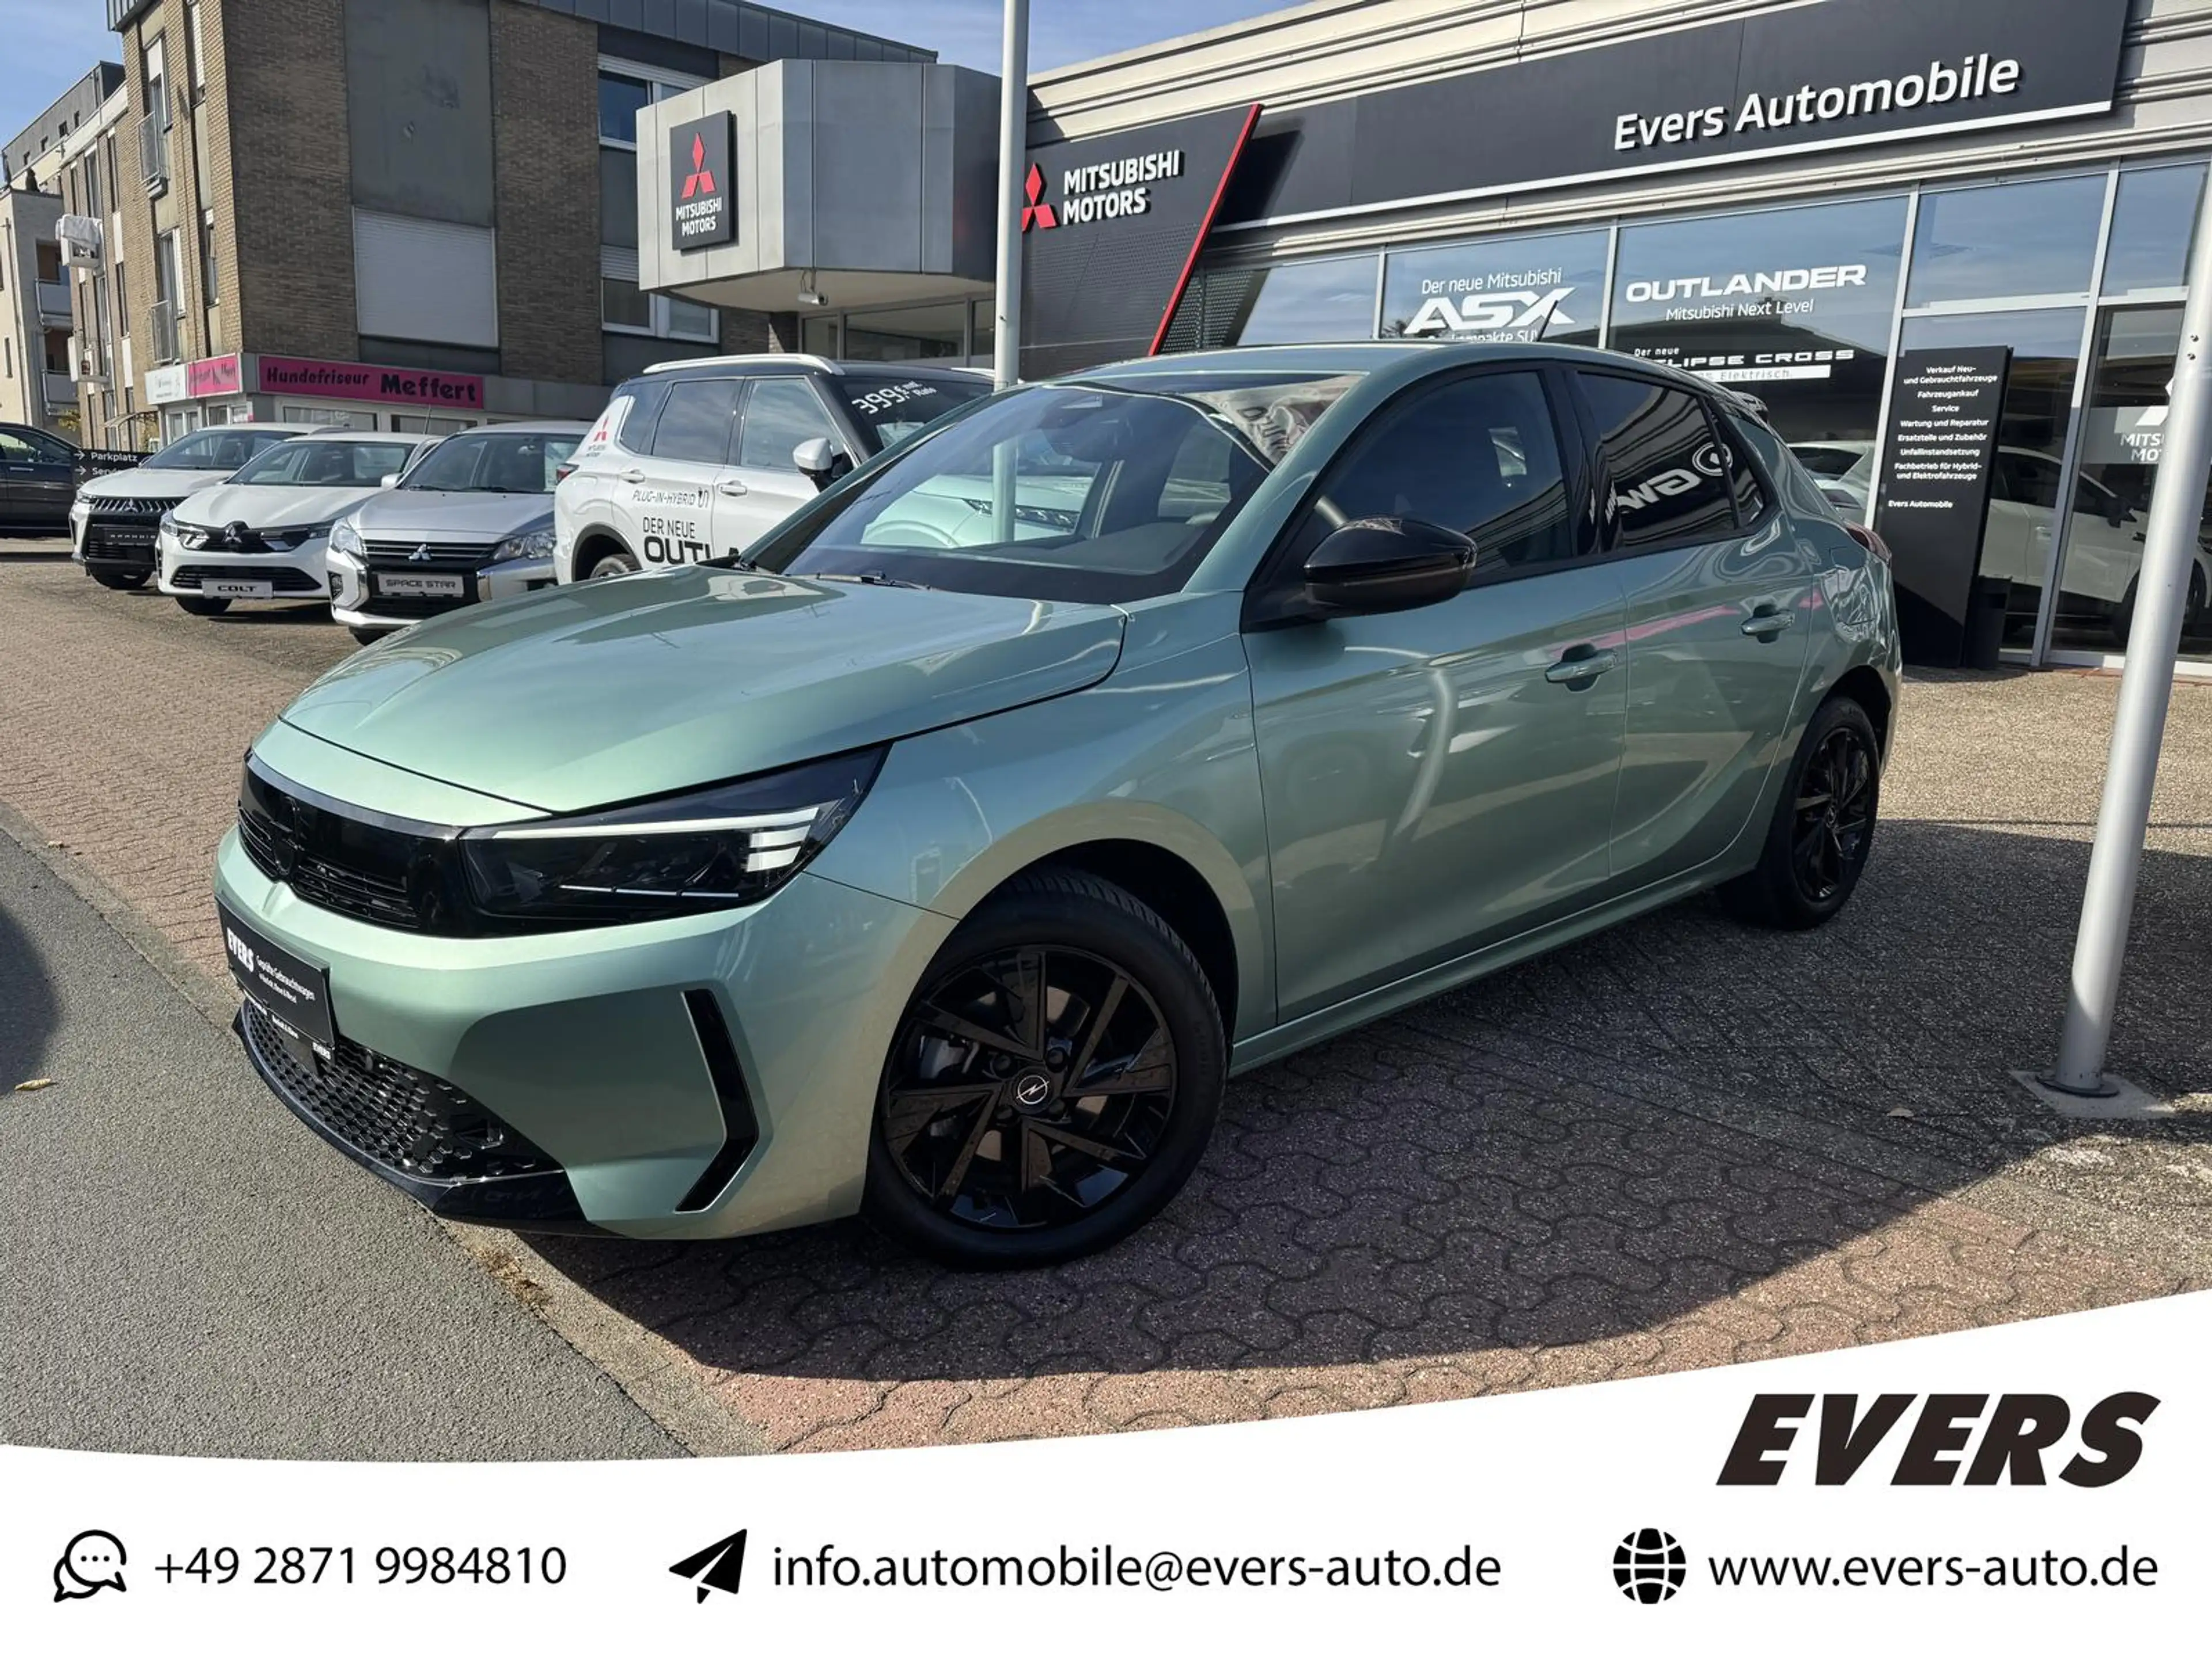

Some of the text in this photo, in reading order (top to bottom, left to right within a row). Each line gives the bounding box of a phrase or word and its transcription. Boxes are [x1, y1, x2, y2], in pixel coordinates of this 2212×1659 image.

[1615, 52, 2020, 151] Evers Automobile
[1063, 149, 1180, 195] MITSUBISHI
[676, 196, 722, 221] MITSUBISHI
[1063, 187, 1146, 225] MOTORS
[681, 215, 716, 236] MOTORS
[1421, 267, 1563, 294] Der neue Mitsubishi
[1625, 264, 1866, 303] OUTLANDER
[1403, 287, 1576, 334] ASX
[1666, 298, 1815, 321] Mitsubishi Next Level
[1634, 347, 1652, 357] Der
[1755, 349, 1855, 364] CROSS
[1926, 365, 1976, 374] Verkauf Neu-
[267, 366, 476, 402] Hundefriseur Meffert
[1903, 374, 1998, 384] und Gebrauchtfahrzeuge
[1917, 389, 1979, 399] Fahrzeugankauf
[1931, 404, 1960, 413] Service
[1900, 420, 1932, 428] Wartung
[1949, 419, 1990, 428] Reparatur
[1897, 434, 1937, 442] Ersatzteile
[1955, 433, 1987, 441] Zubehör
[2120, 433, 2165, 447] MITS
[91, 452, 138, 462] Parkplatz
[1900, 448, 1980, 457] Unfallinstandsetzung
[2131, 449, 2162, 461] MO
[1952, 463, 1983, 471] Hybrid-
[1912, 472, 1978, 481] Elektrofahrzeuge
[632, 490, 696, 505] PLUG-IN-HYBRID
[1910, 500, 1954, 508] Automobile
[643, 517, 695, 539] DER NEUE
[386, 578, 457, 589] SPACE STAR
[226, 926, 255, 973] EVERS
